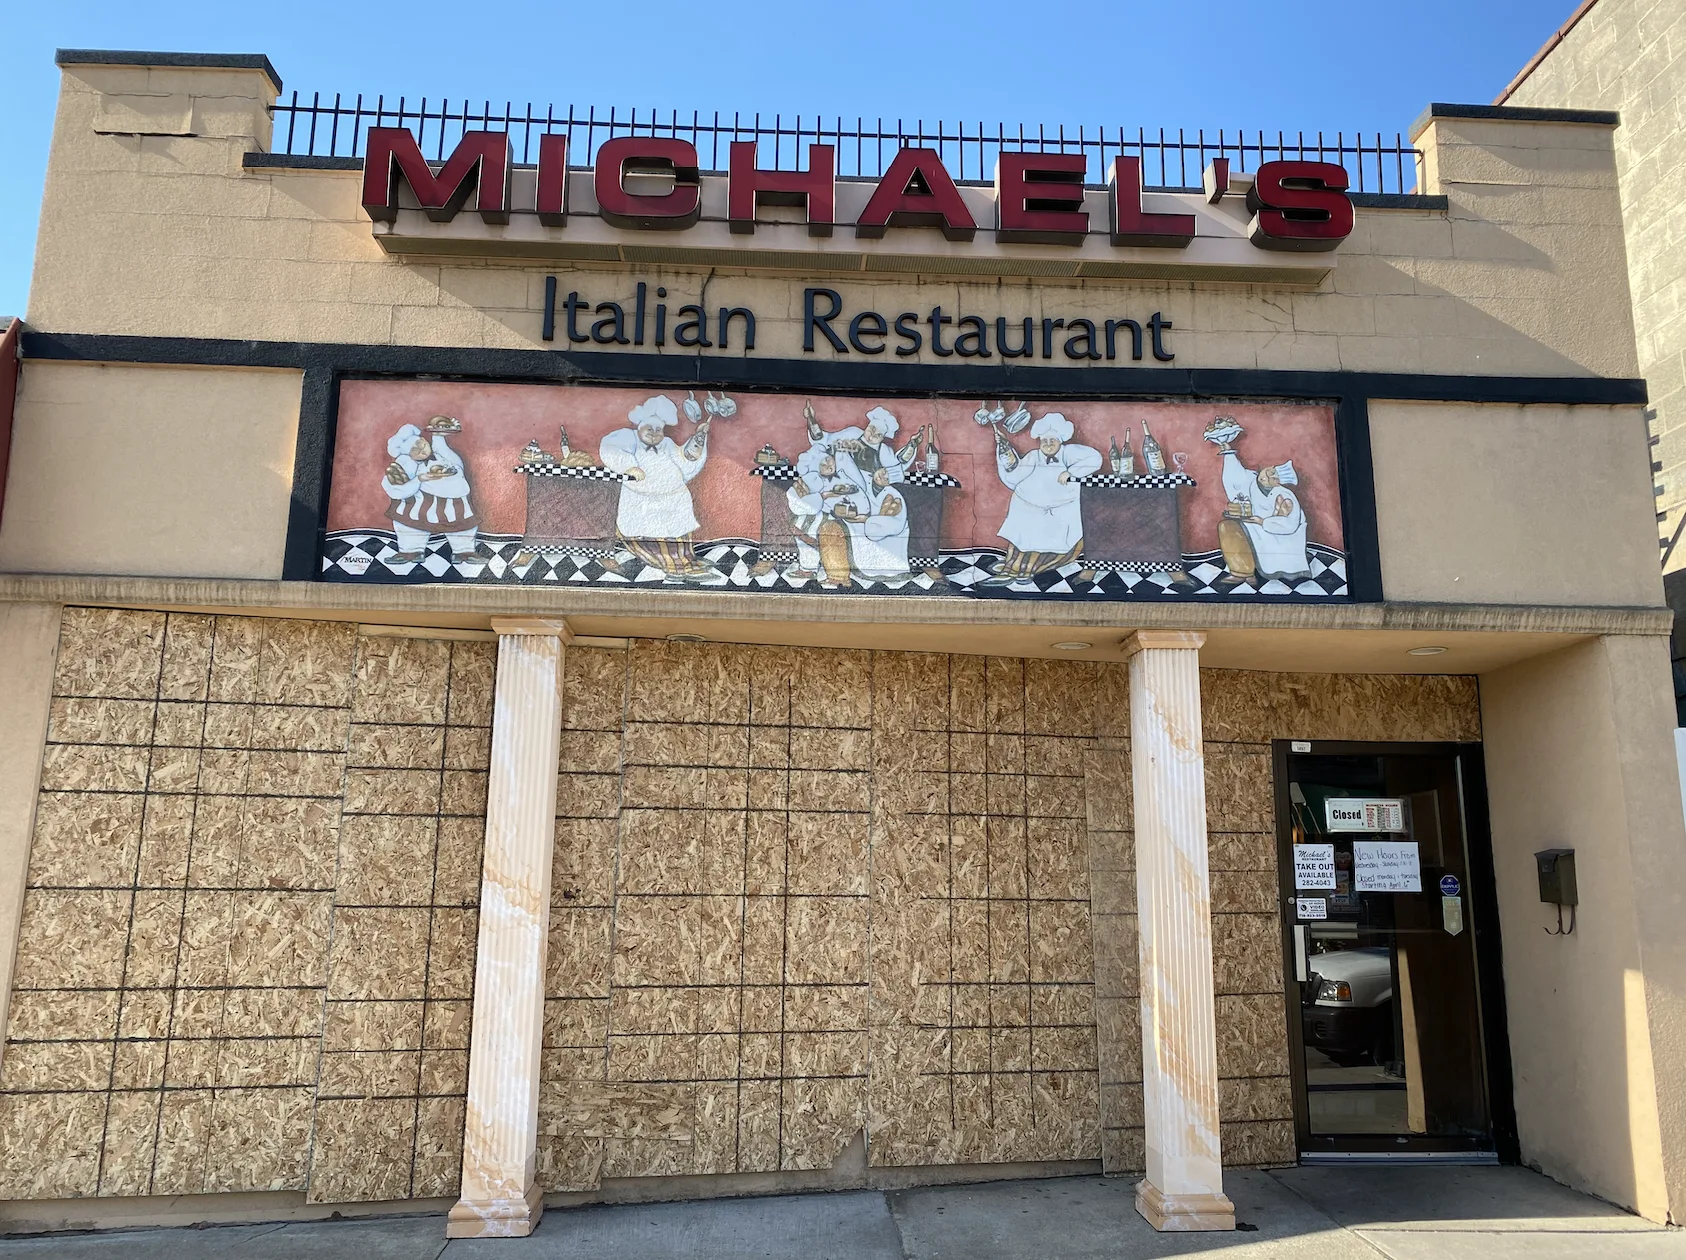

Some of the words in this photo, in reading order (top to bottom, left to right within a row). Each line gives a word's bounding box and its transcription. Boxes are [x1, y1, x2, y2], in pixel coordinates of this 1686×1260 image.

[362, 126, 1355, 248] MICHAEL'S
[542, 276, 756, 350] Italian
[803, 288, 1176, 361] Restaurant
[1332, 809, 1362, 819] Closed
[1298, 849, 1331, 857] Michael's
[1355, 848, 1374, 861] New
[1376, 848, 1399, 860] Hours
[1400, 850, 1416, 860] From
[1356, 873, 1375, 883] Closed
[1389, 881, 1402, 889] April
